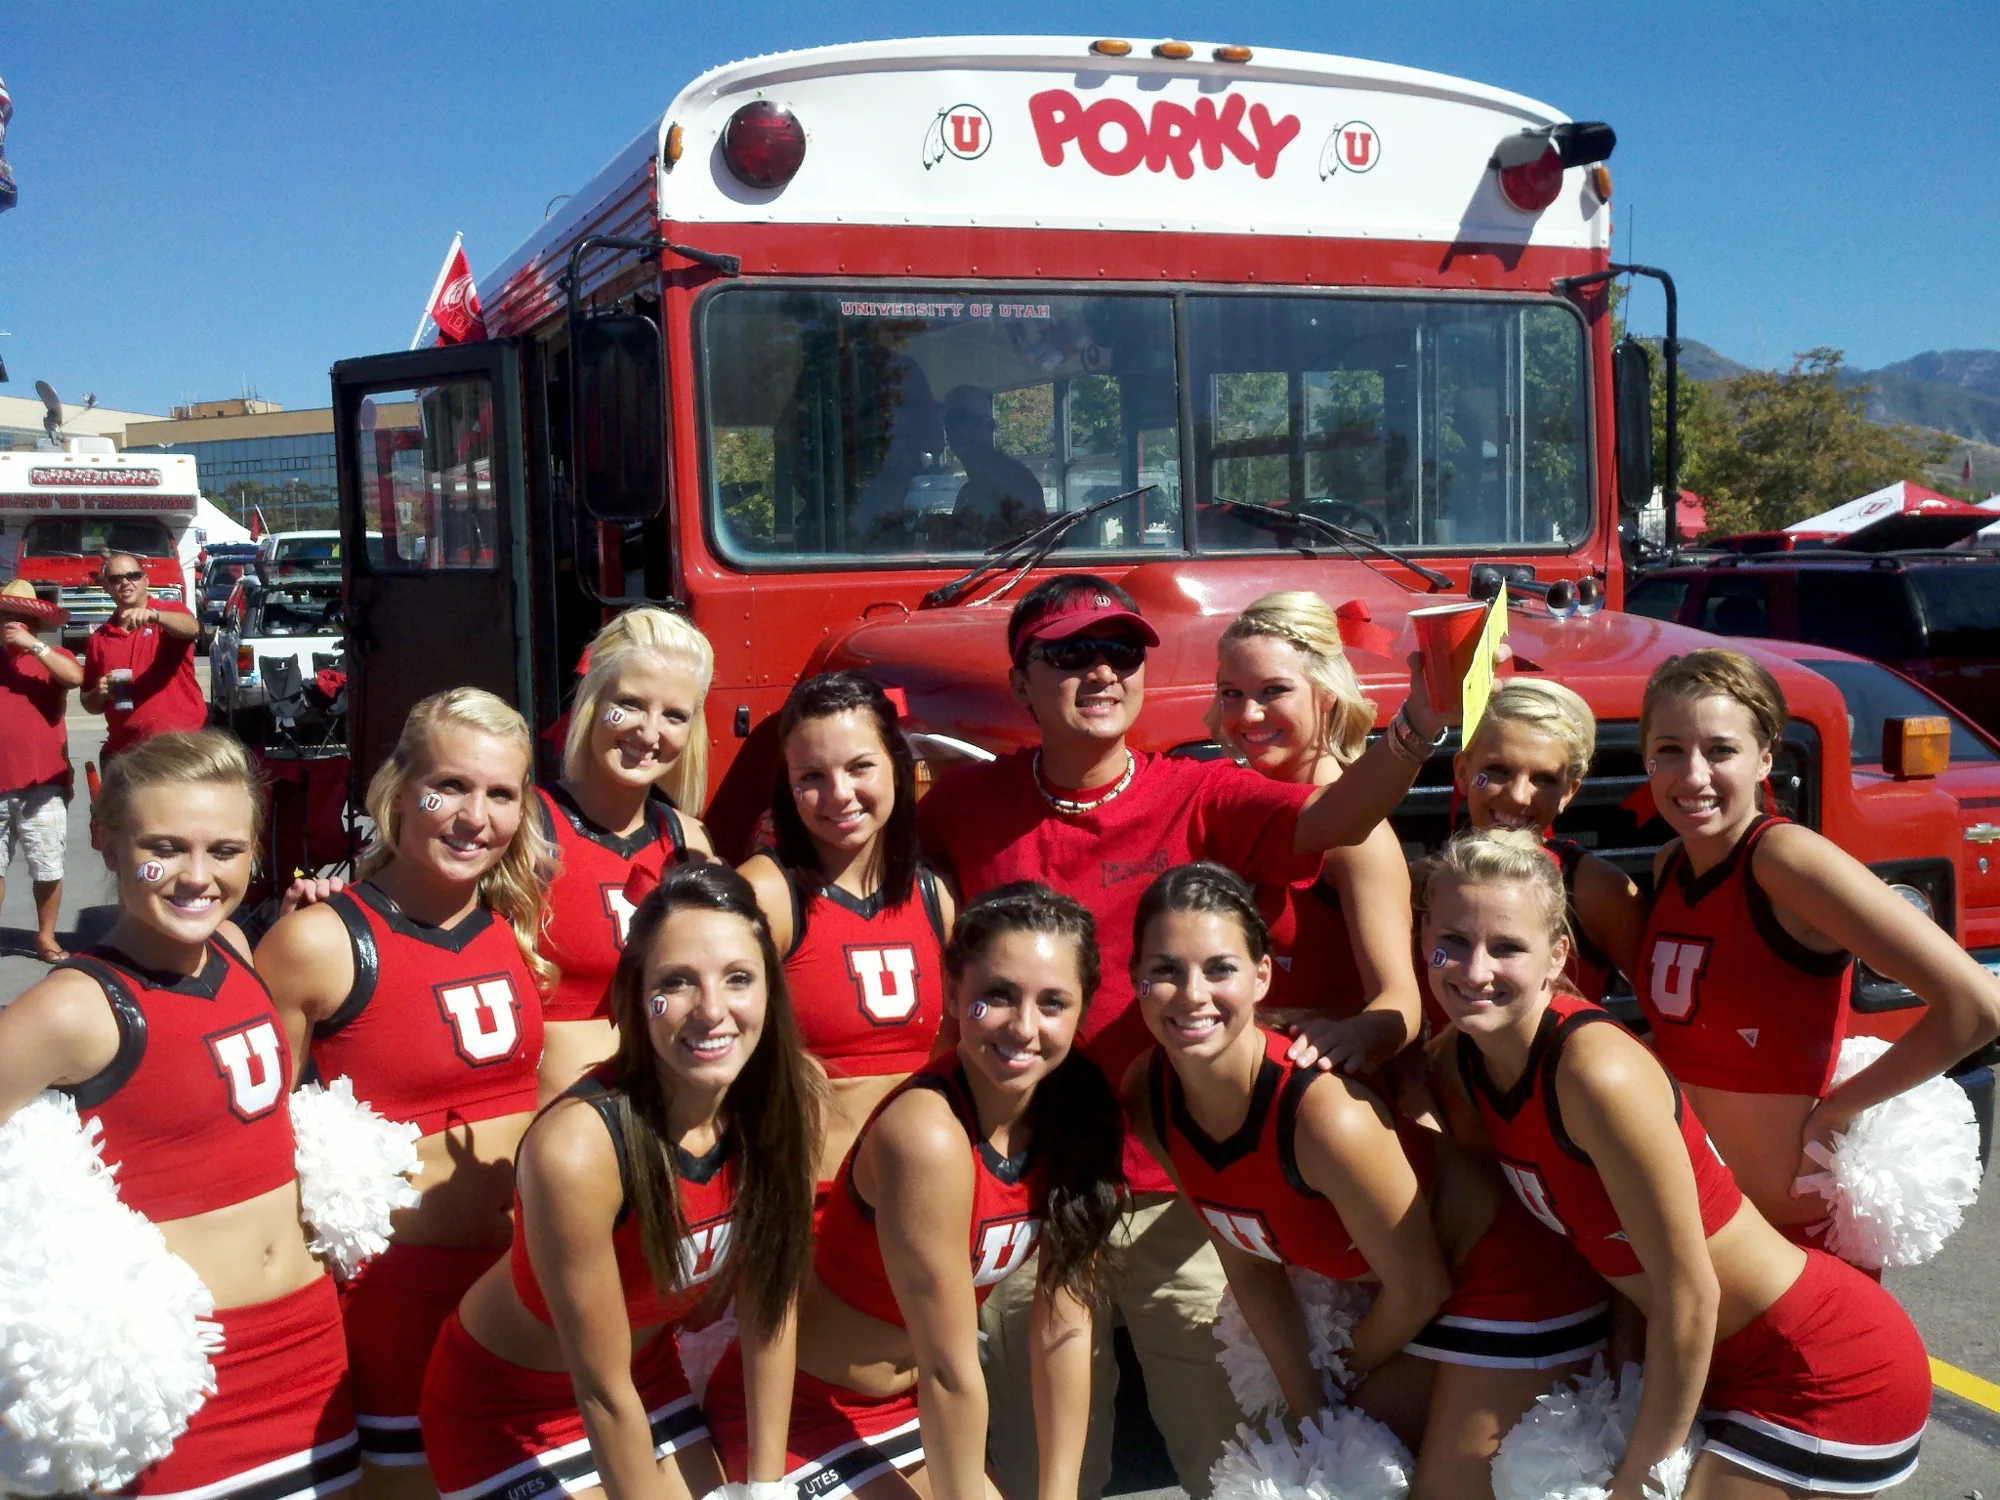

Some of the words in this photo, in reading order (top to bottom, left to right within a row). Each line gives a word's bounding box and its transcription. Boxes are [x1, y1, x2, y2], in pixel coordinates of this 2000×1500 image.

[951, 115, 982, 153] U
[1028, 89, 1301, 180] PORKY
[1345, 131, 1372, 166] U
[841, 302, 964, 316] UNIVERSITY
[969, 303, 993, 317] OF
[999, 304, 1051, 318] UTAH
[847, 945, 918, 1022] U
[1649, 937, 1709, 1021] U
[437, 975, 518, 1064] U
[209, 1017, 283, 1118] U
[972, 1217, 1041, 1287] U
[508, 1476, 546, 1500] UTES
[804, 1469, 839, 1494] UTES
